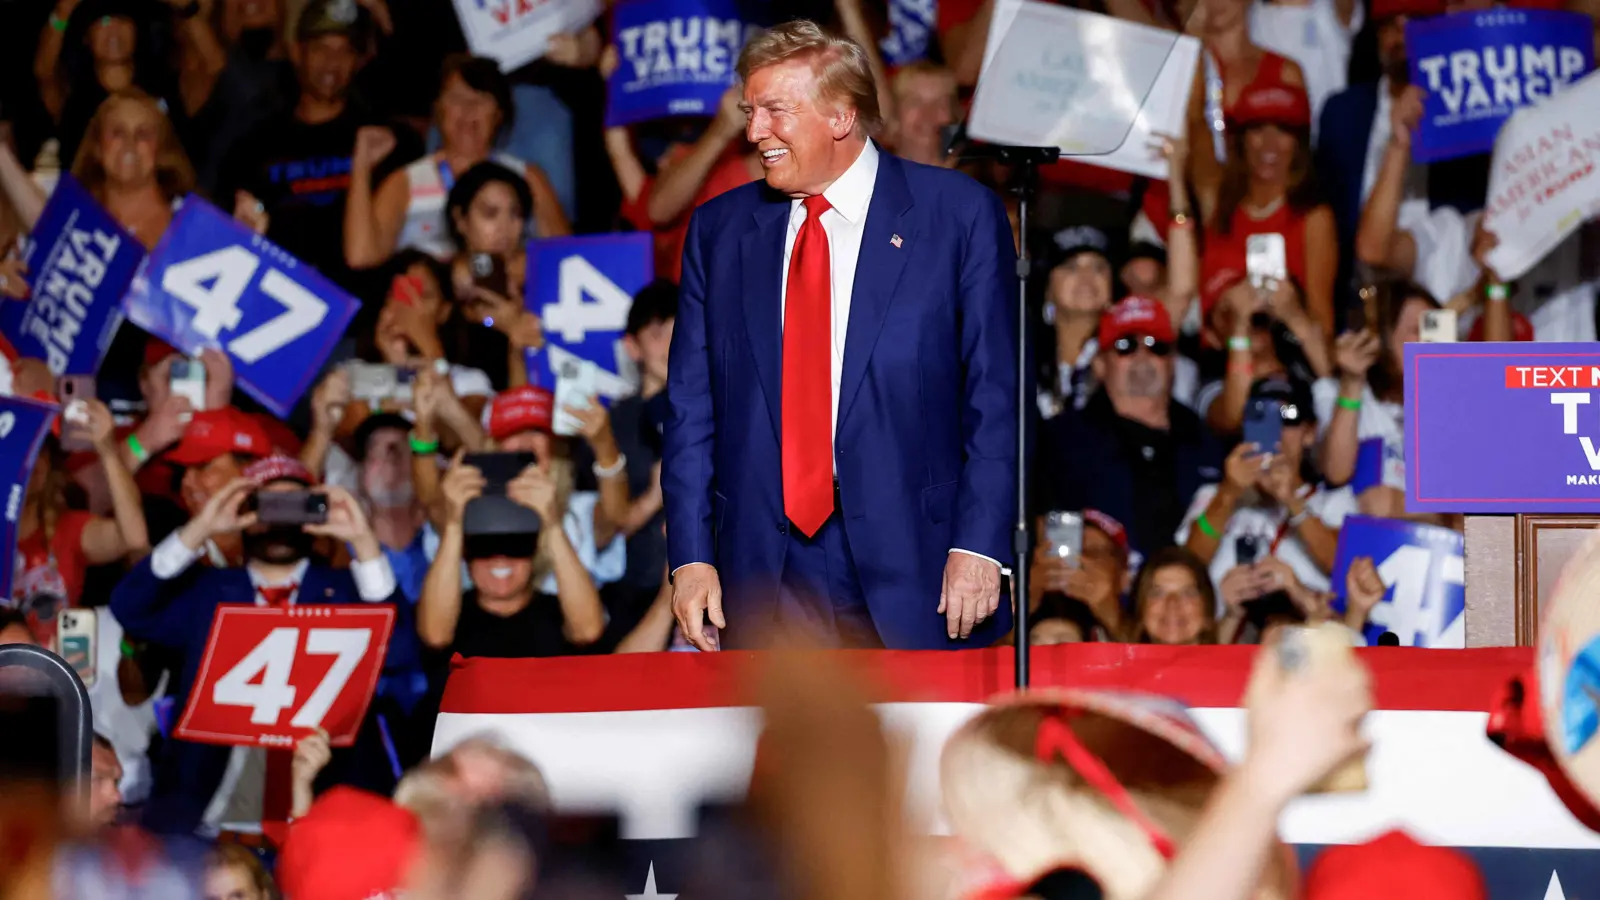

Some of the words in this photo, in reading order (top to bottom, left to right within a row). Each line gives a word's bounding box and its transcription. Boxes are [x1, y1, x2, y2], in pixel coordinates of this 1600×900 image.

[619, 16, 741, 60] TRUM
[633, 46, 738, 79] VANC
[1419, 43, 1585, 93] TRUMP
[1502, 122, 1575, 175] ASIAN
[28, 228, 95, 346] VANCE
[47, 228, 121, 377] TRUMP
[161, 244, 330, 365] 47
[1516, 366, 1583, 387] TEXT
[1566, 474, 1600, 486] MAK
[212, 626, 373, 728] 47
